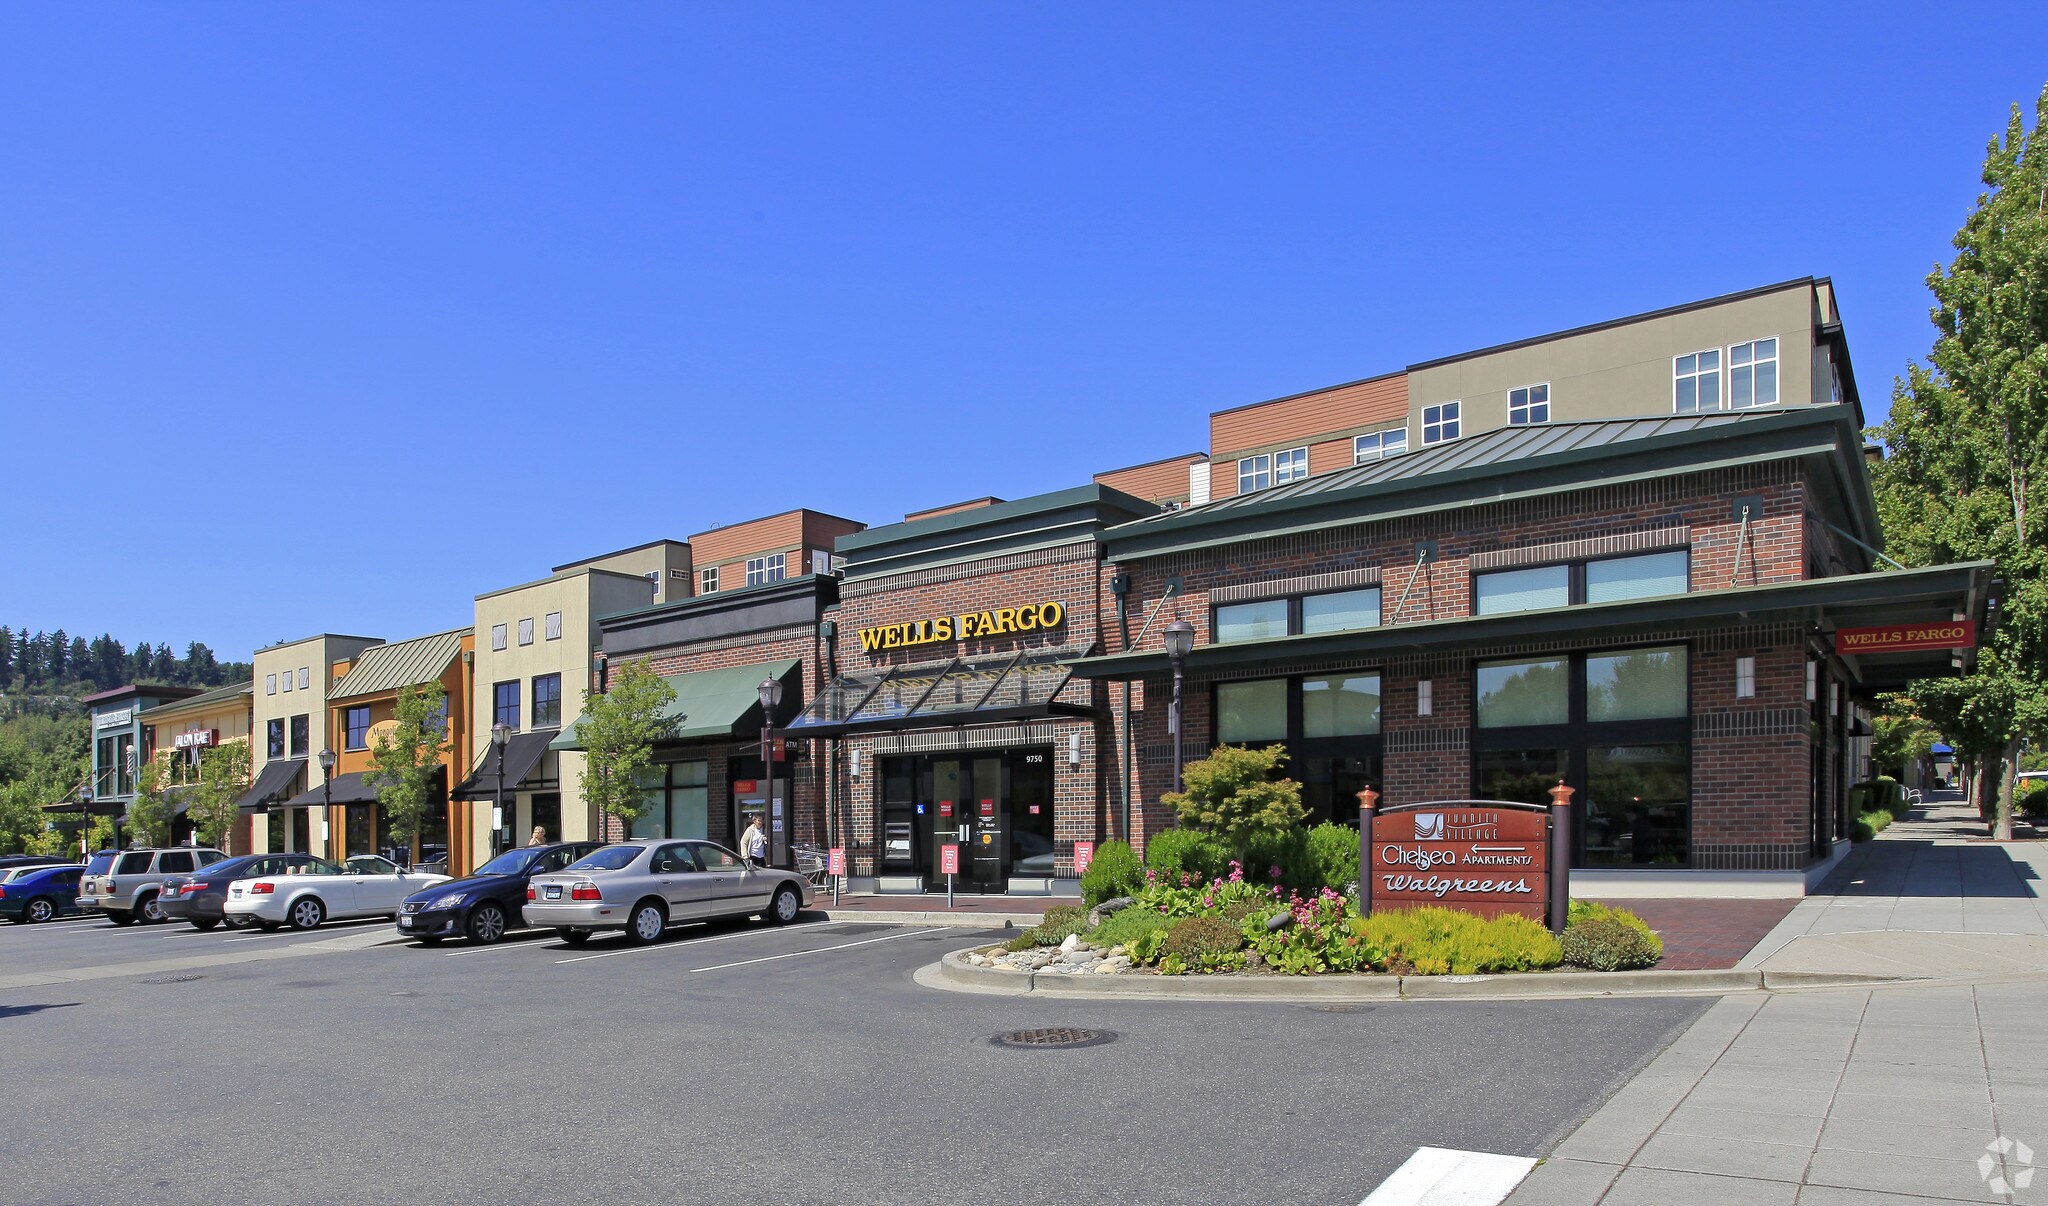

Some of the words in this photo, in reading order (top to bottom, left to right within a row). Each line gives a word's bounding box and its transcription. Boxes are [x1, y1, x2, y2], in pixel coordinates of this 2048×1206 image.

[857, 617, 952, 651] WELLS
[958, 601, 1063, 639] FARGO
[1843, 631, 1902, 645] WELLS
[1905, 627, 1965, 641] FARGO
[1026, 755, 1043, 763] 9750
[1446, 813, 1499, 823] JUANITA
[1446, 828, 1497, 840] VILLAGE
[1382, 844, 1456, 871] Chelsea
[1462, 854, 1533, 865] APARTMENTS
[1382, 874, 1532, 898] Walgreens
